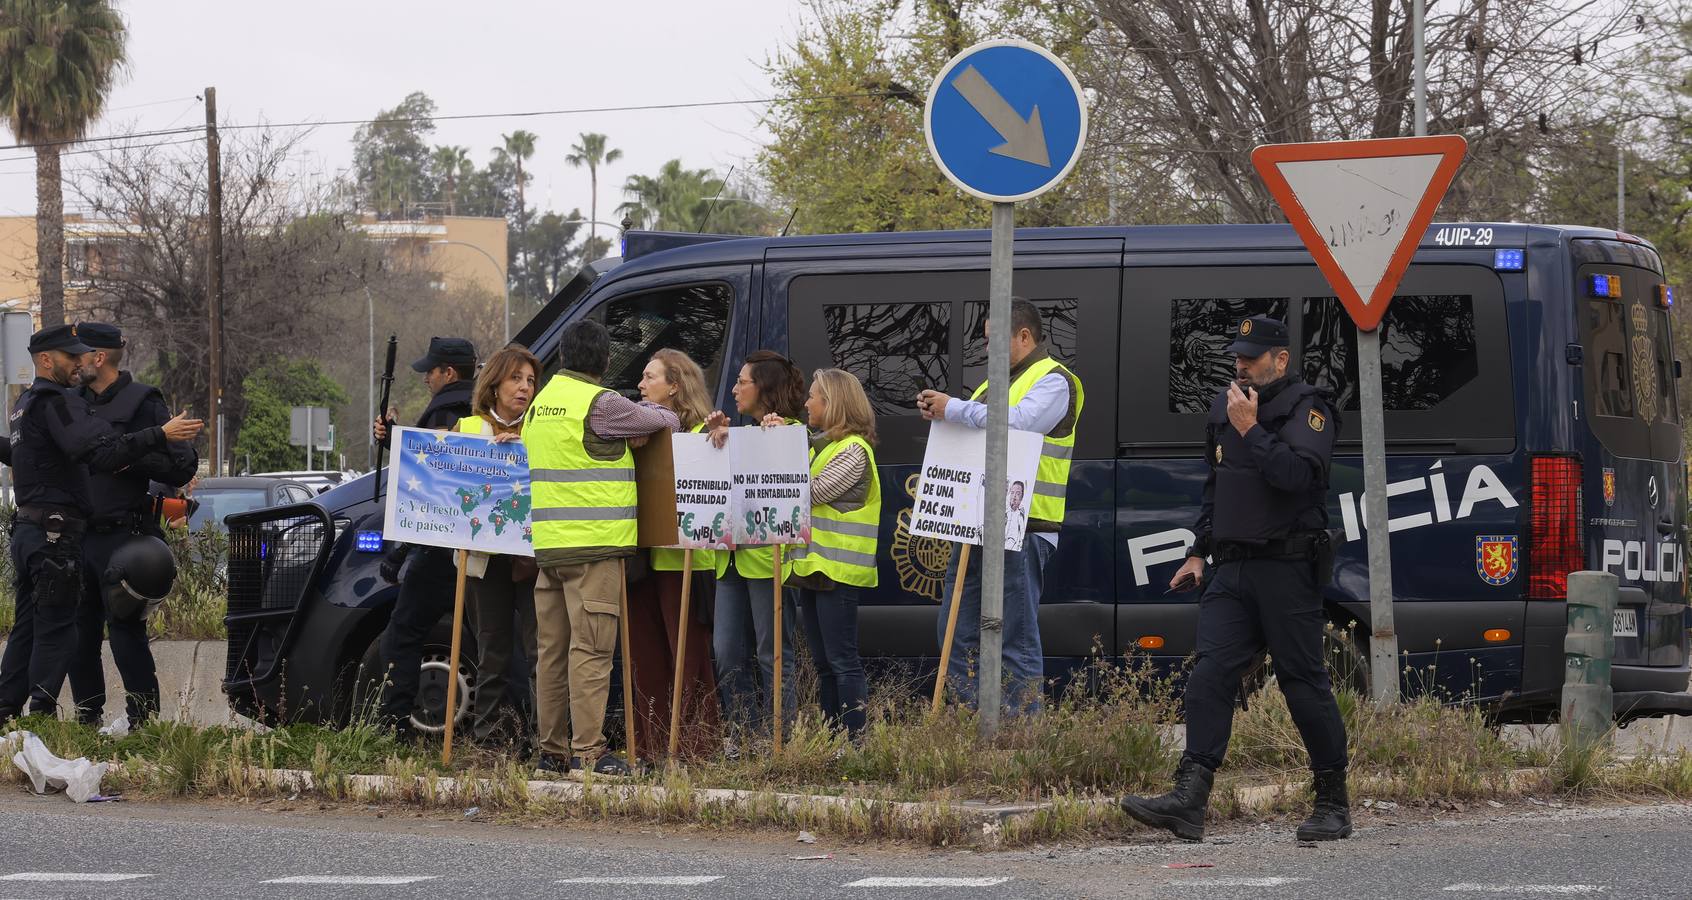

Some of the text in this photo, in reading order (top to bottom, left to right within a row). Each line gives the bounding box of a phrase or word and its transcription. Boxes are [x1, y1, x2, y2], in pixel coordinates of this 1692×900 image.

[1435, 227, 1493, 246] 4UIP-29
[536, 404, 567, 417] Citran
[408, 439, 528, 465] La Agricultura Europe
[428, 459, 510, 479] sigue las reglas,
[926, 465, 972, 485] CÓMPLICES
[676, 479, 732, 491] SOSTENIBILID
[733, 473, 808, 485] NO HAY SOSTENIBILIDAD
[676, 493, 727, 505] ENTABILIDAD
[744, 488, 801, 499] SIN RENTABILIDAD
[922, 483, 954, 499] DE UNA
[420, 502, 429, 513] el
[432, 505, 459, 517] resto
[918, 500, 955, 518] PAC SIN
[400, 517, 413, 529] de
[915, 519, 977, 539] AGRICULTORES
[1127, 459, 1520, 587] PICÍA
